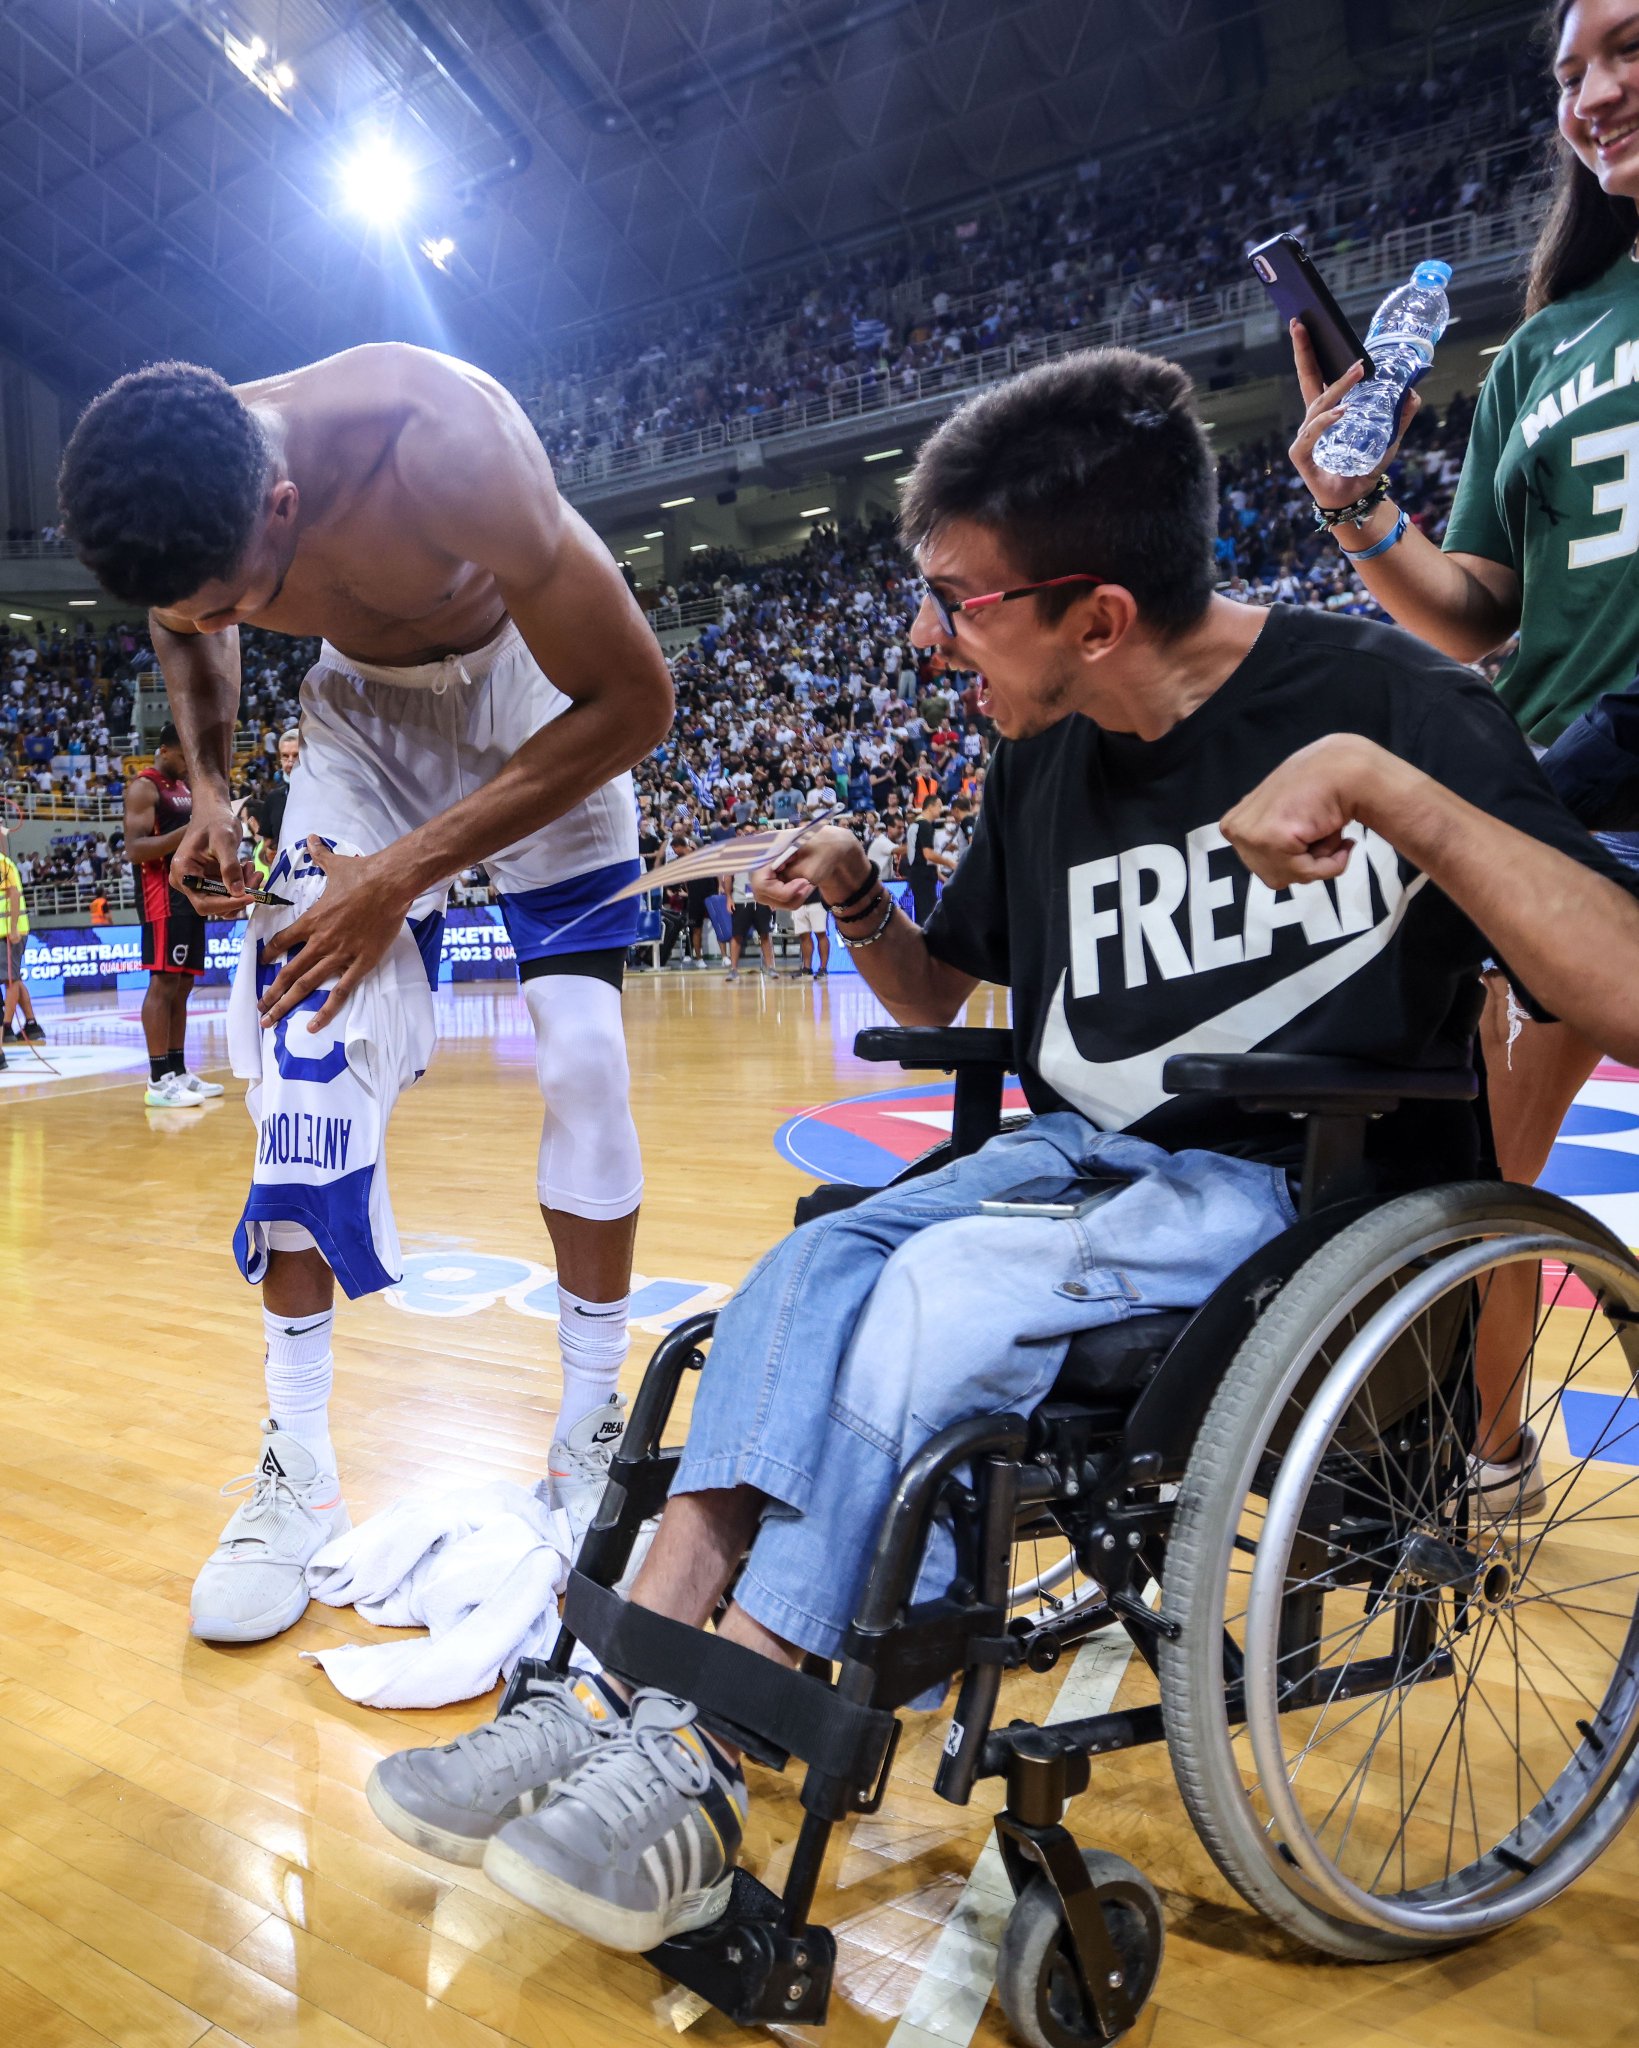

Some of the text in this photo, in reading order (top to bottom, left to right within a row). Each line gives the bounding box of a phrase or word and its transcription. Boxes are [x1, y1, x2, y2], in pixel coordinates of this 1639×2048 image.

[24, 943, 142, 965] BASKETBALL
[450, 945, 492, 962] 2023
[31, 964, 61, 980] CUP
[62, 962, 98, 978] 2023
[100, 960, 143, 976] QUALIFIERS
